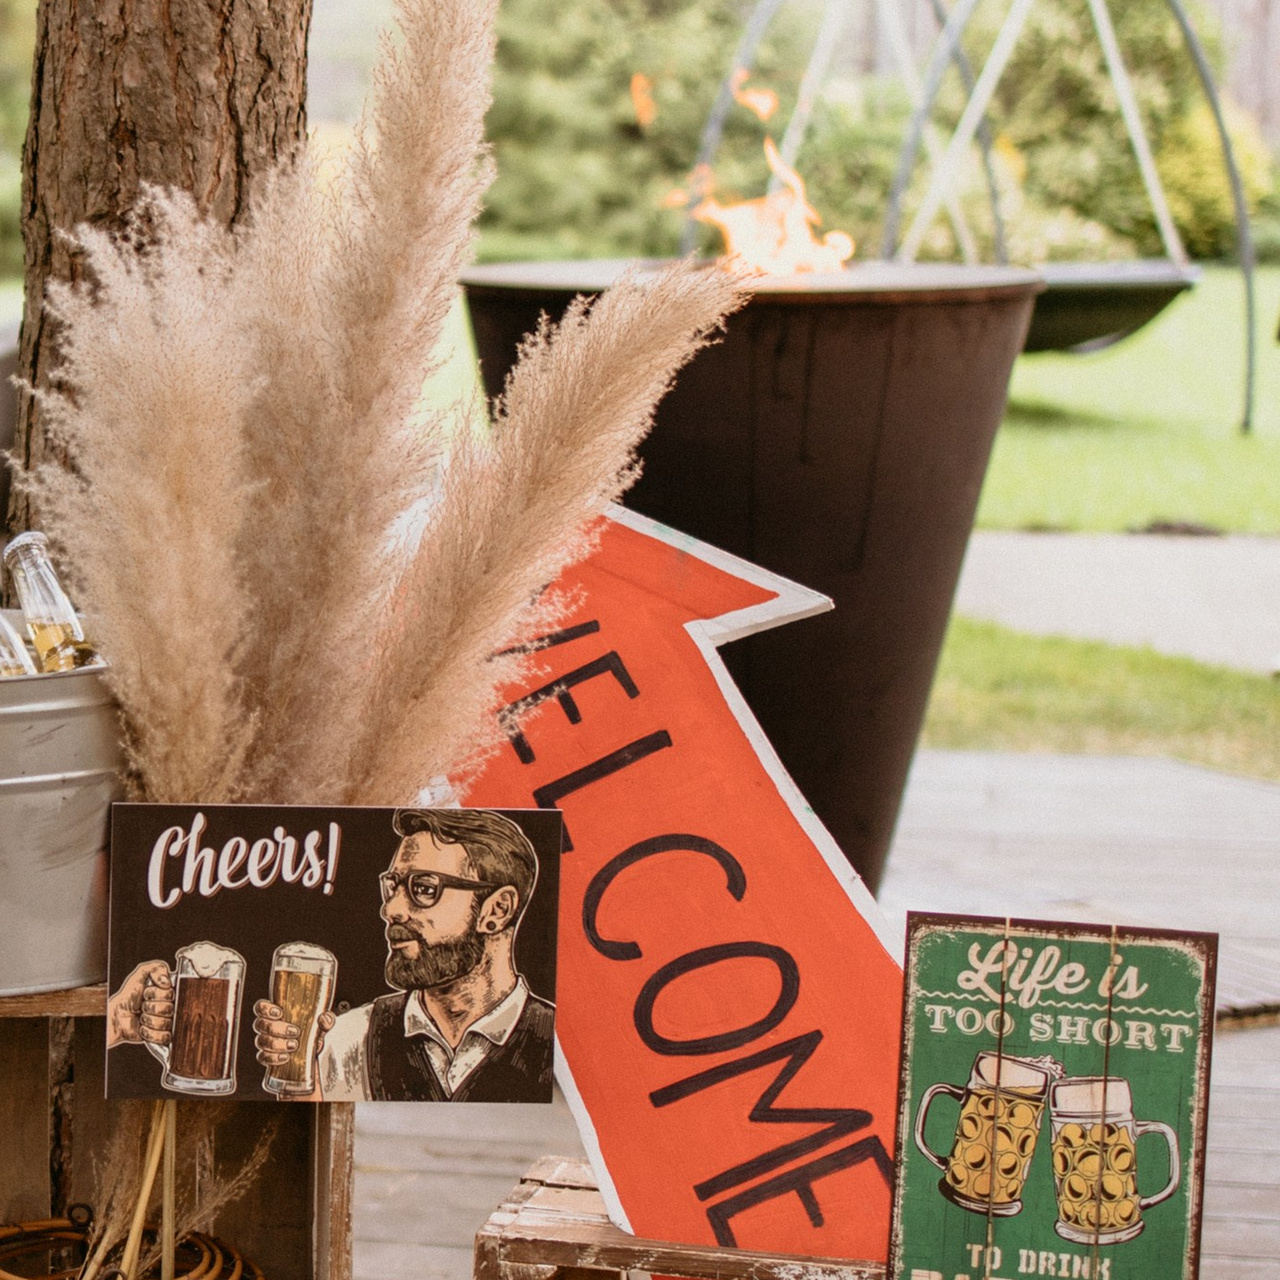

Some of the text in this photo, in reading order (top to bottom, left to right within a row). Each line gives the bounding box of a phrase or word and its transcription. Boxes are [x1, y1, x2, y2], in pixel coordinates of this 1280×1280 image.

[147, 812, 341, 909] Cheers!
[958, 940, 1148, 1009] Life is
[925, 1005, 1193, 1052] TOO SHORT
[966, 1243, 1002, 1271] TO
